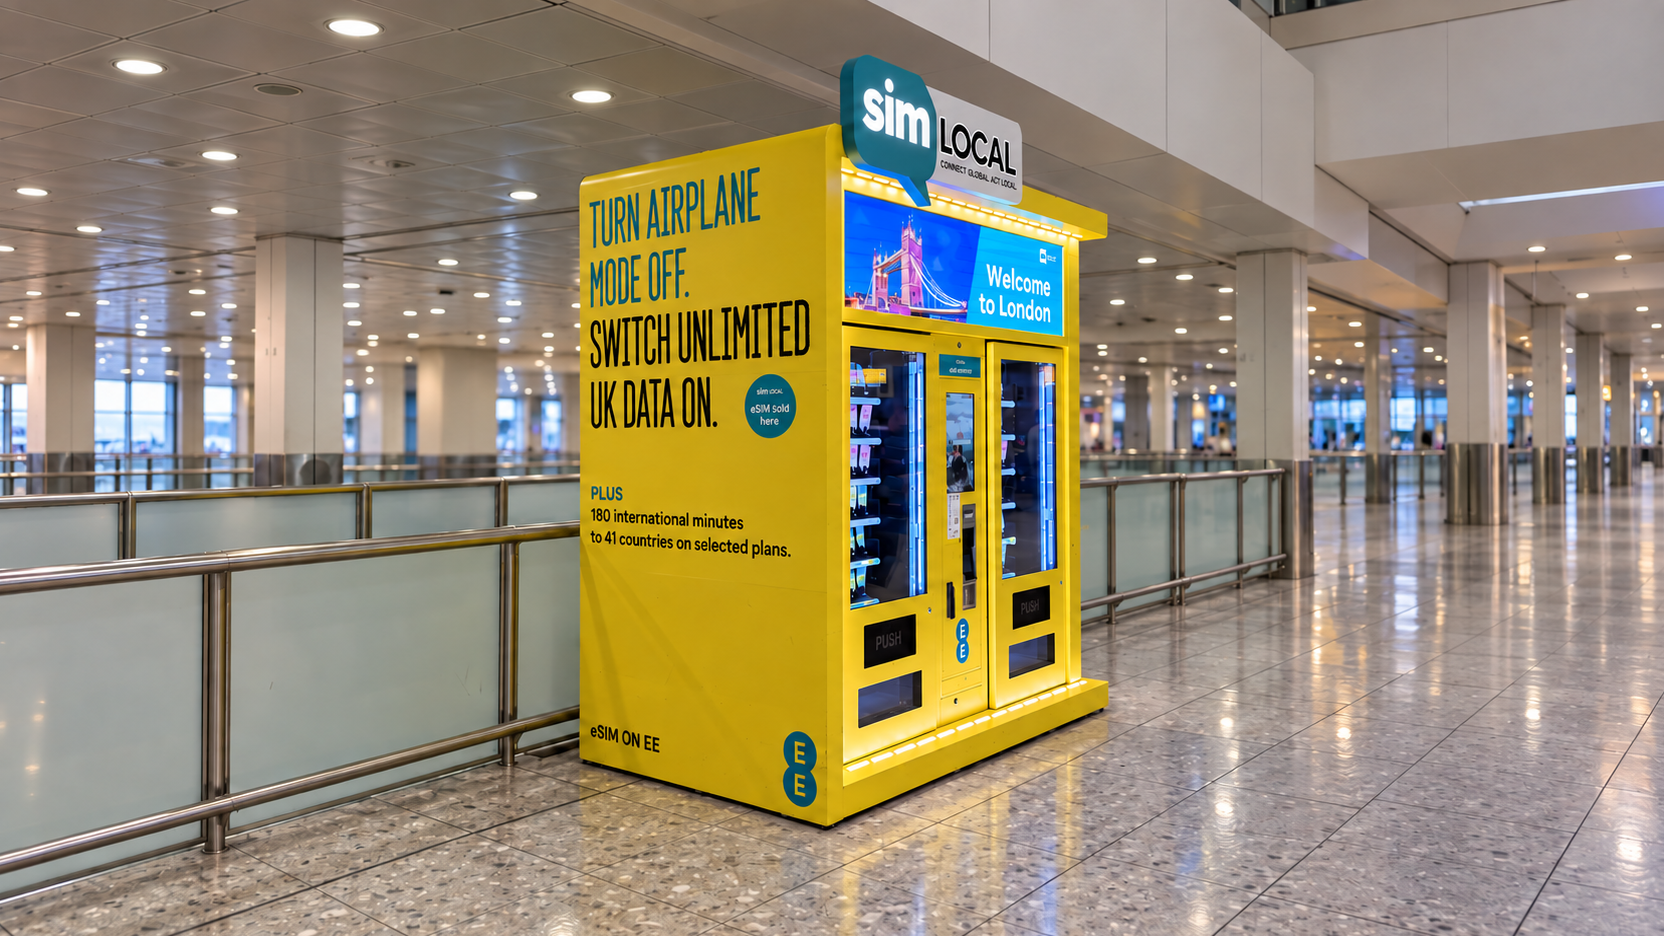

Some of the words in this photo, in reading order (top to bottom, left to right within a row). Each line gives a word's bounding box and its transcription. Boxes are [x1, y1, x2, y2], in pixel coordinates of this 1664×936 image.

[862, 78, 931, 149] sim
[940, 117, 1017, 176] LOCAL
[940, 160, 967, 174] CONNECT
[968, 168, 989, 182] GLOBAL
[991, 175, 1000, 185] ACT
[589, 193, 640, 249] TURN
[646, 167, 761, 239] AIRPLANE
[590, 254, 642, 308] MODE
[648, 247, 690, 302] OFF.
[986, 263, 1051, 297] Welcome
[979, 293, 995, 315] to
[999, 295, 1051, 323] London
[590, 313, 671, 369] SWITCH
[678, 299, 810, 363] UNLIMITED
[591, 380, 617, 429] UK
[623, 377, 675, 429] DATA
[682, 376, 718, 429] ON.
[756, 387, 769, 396] sim
[750, 404, 771, 414] eSIM
[772, 403, 790, 414] sold
[760, 416, 780, 426] here
[591, 486, 623, 501] PLUS
[591, 508, 611, 522] 180
[613, 509, 690, 527] international
[692, 513, 744, 530] minutes
[590, 530, 602, 544] to
[604, 531, 616, 545] 41
[619, 533, 674, 549] countries
[676, 538, 692, 550] on
[694, 537, 749, 555] selected
[752, 540, 792, 559] plans.
[1020, 599, 1040, 615] PUSH
[875, 631, 902, 651] PUSH
[590, 724, 619, 743] eSIM
[622, 730, 640, 748] ON
[644, 735, 660, 753] EE
